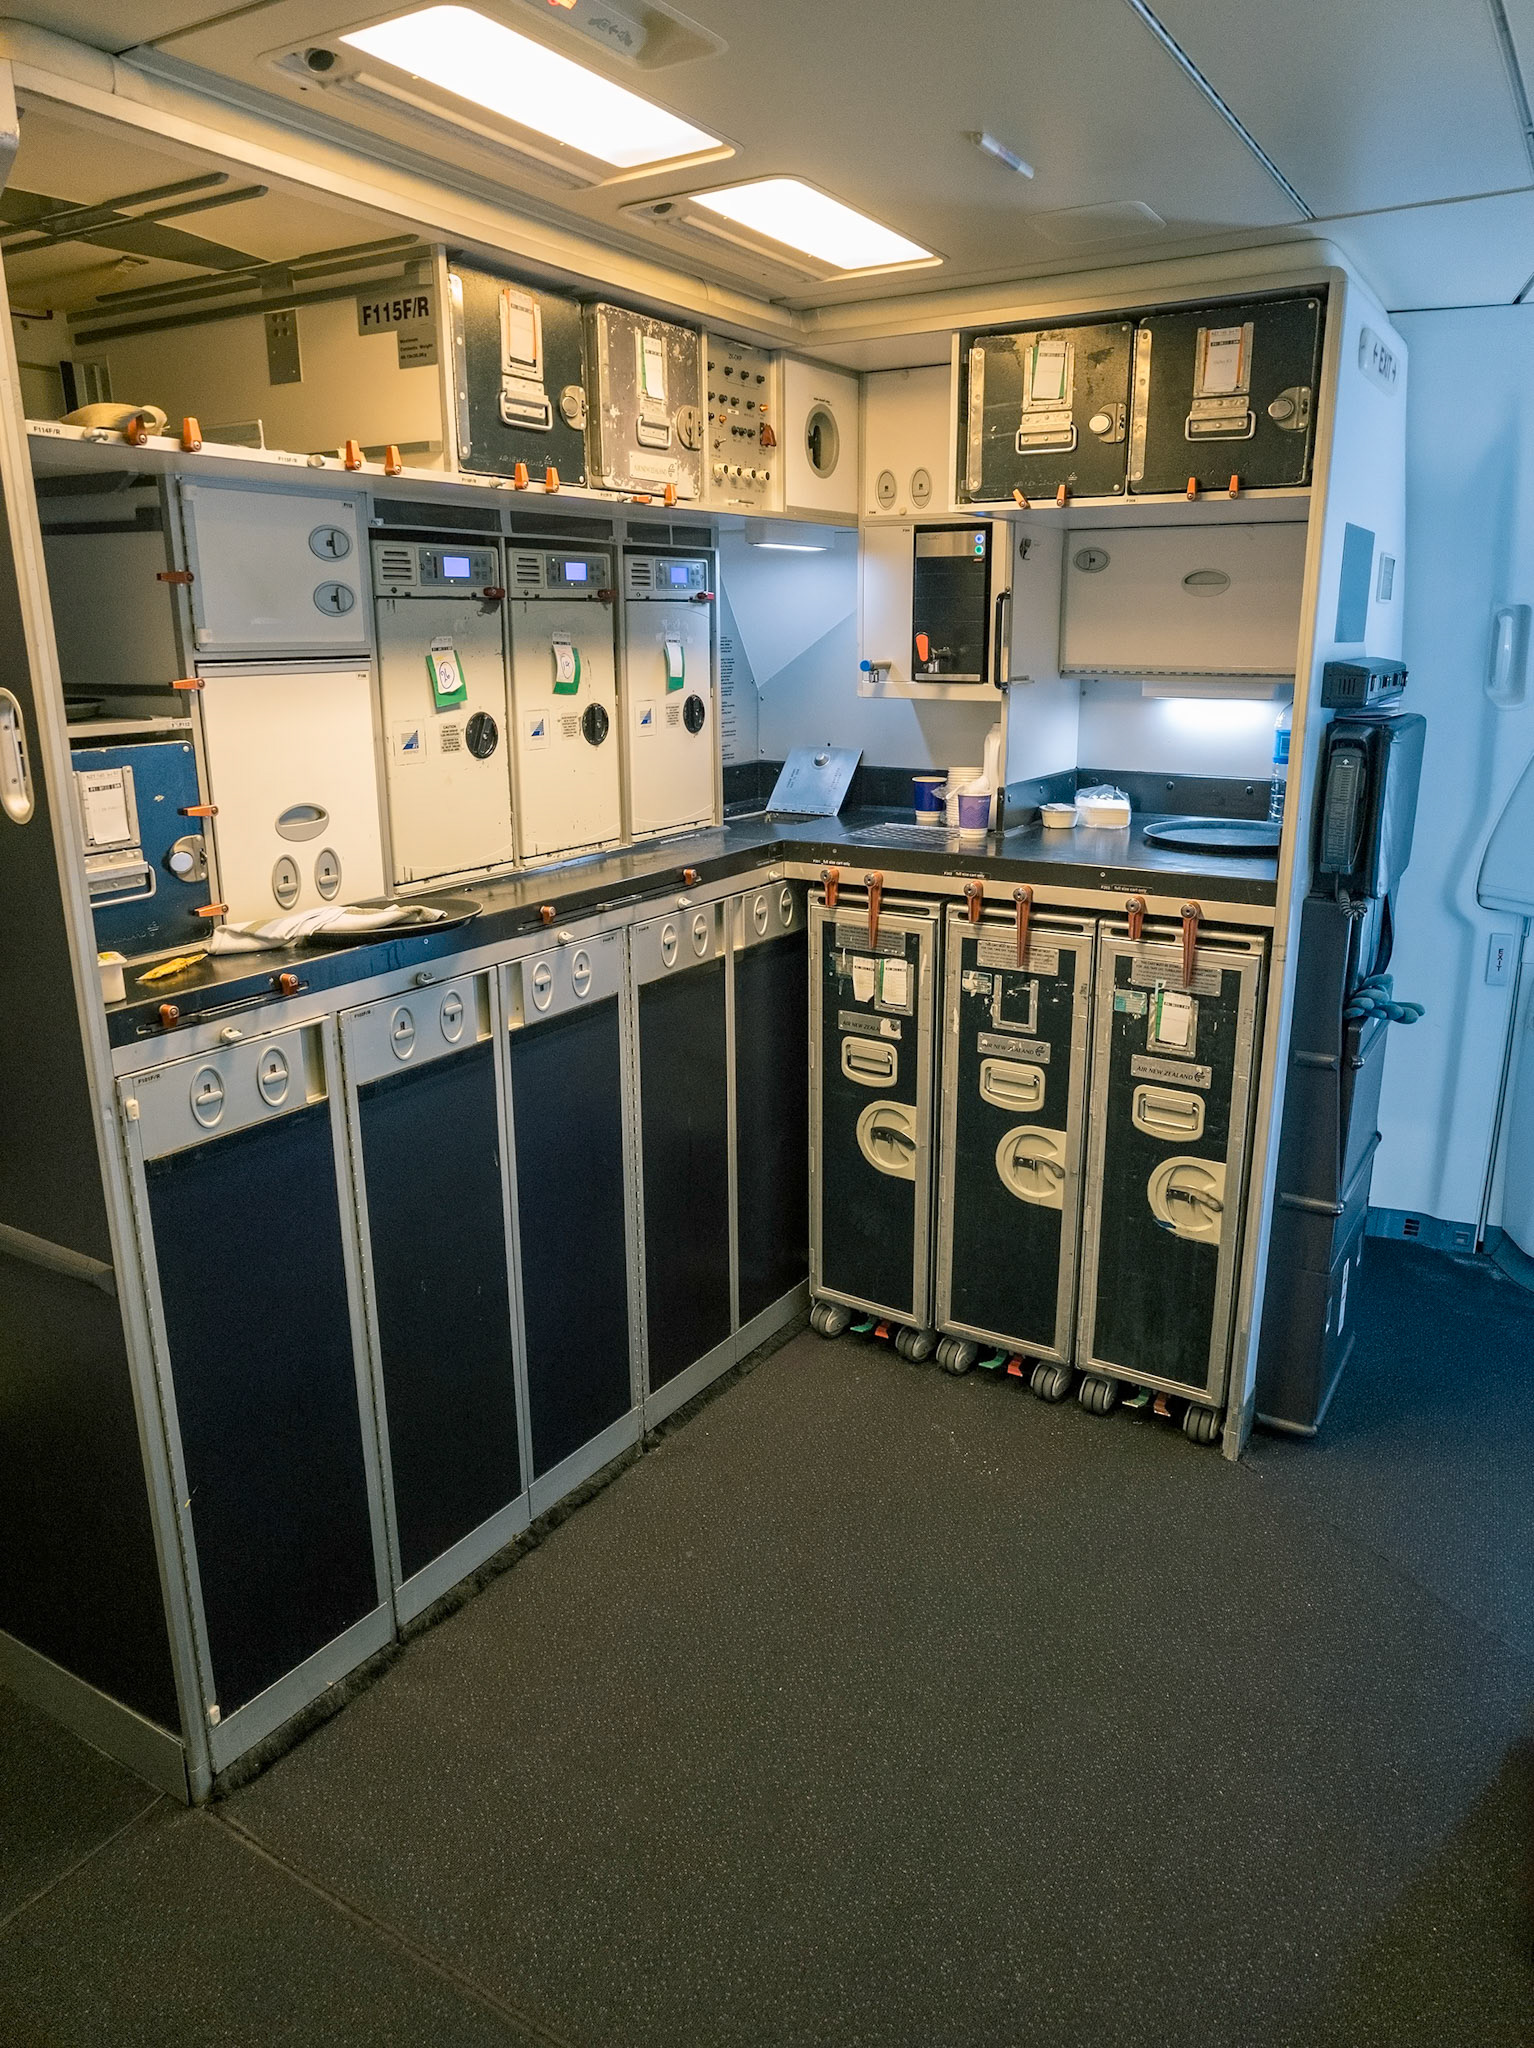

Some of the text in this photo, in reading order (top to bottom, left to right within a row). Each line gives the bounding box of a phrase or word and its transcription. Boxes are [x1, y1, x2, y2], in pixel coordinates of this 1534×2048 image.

[362, 296, 429, 326] F115F/R
[1378, 345, 1393, 381] EXIT
[33, 426, 61, 435] F114F/R
[1496, 948, 1504, 972] EXIT
[1164, 1070, 1193, 1080] ZEALAND
